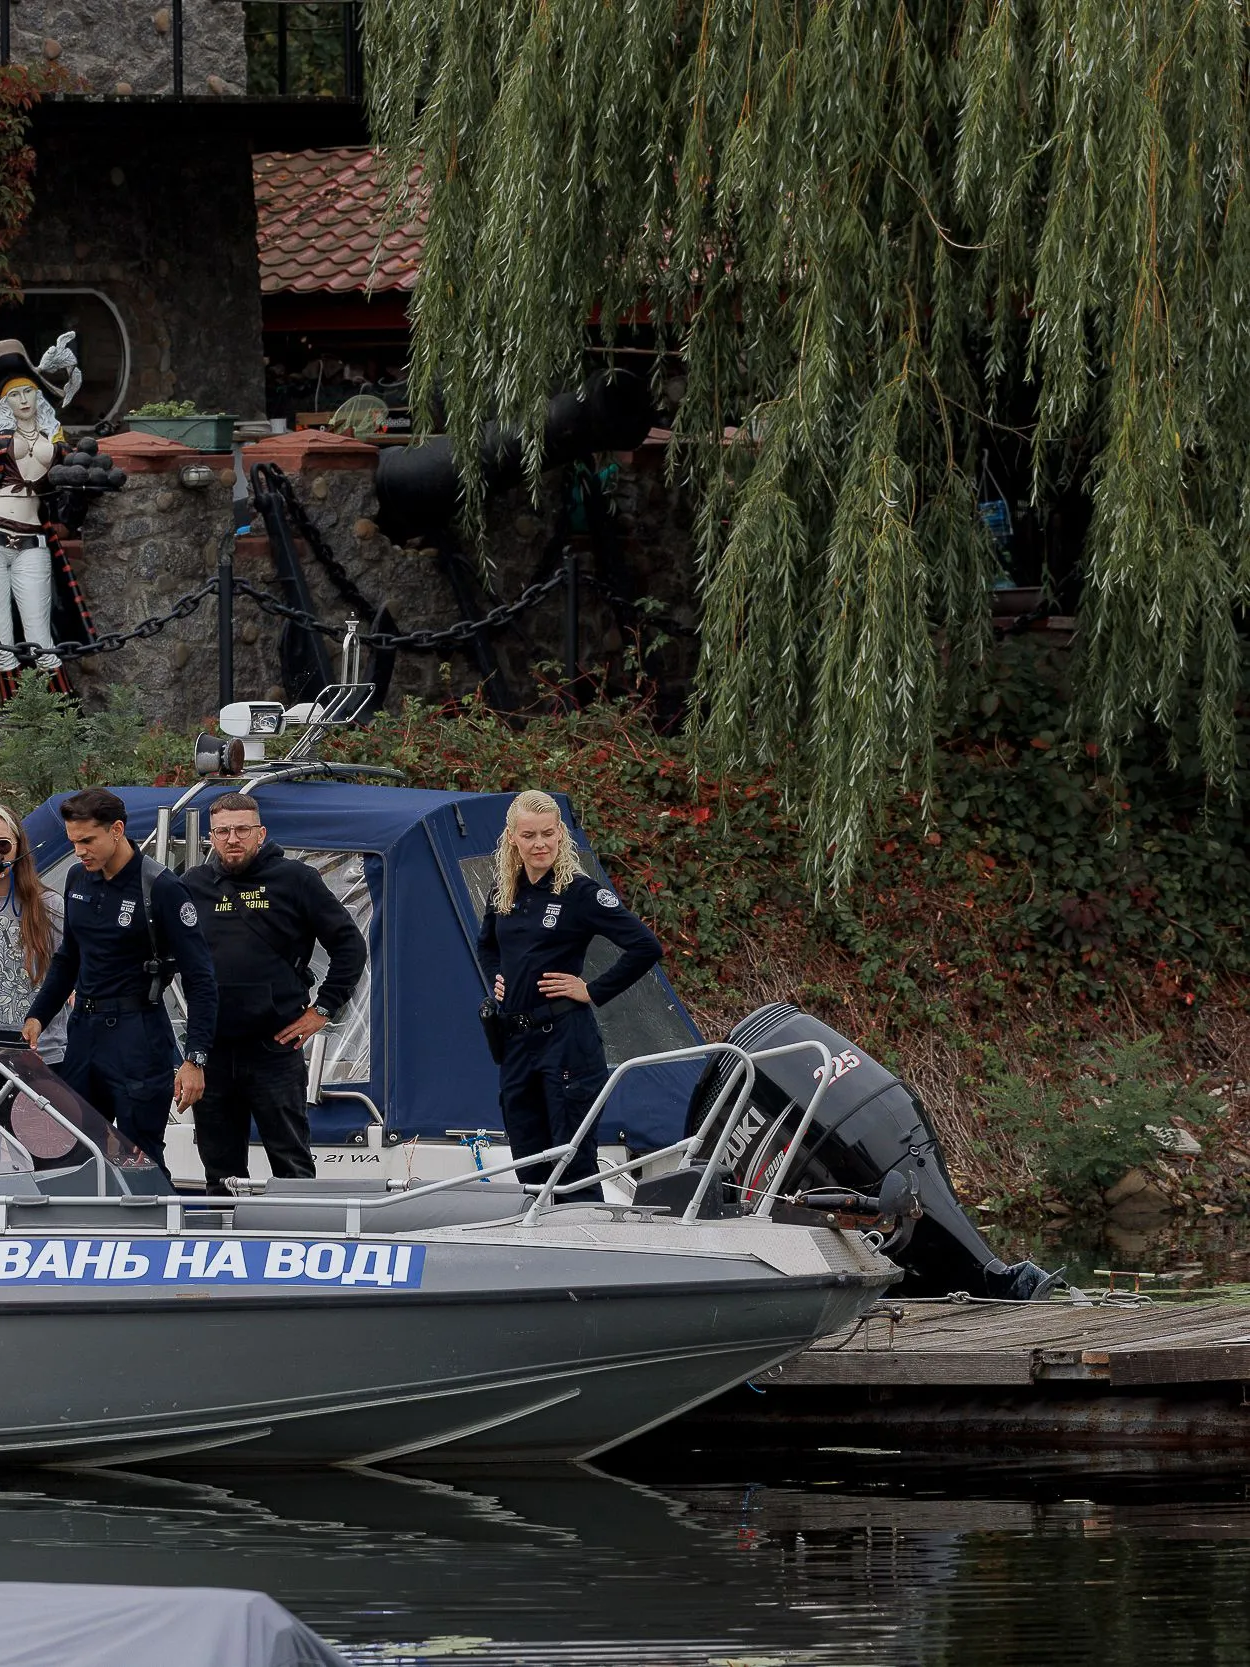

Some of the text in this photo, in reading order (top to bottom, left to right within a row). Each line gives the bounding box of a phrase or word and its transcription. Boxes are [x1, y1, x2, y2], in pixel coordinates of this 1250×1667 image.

[214, 902, 232, 912] LIKE
[813, 1049, 862, 1087] 225
[718, 1106, 766, 1171] ZUKI
[323, 1154, 345, 1163] 21
[350, 1154, 381, 1163] WA
[764, 1150, 786, 1182] FOUR
[162, 1240, 249, 1279] НА
[263, 1241, 412, 1286] ВОДІ
